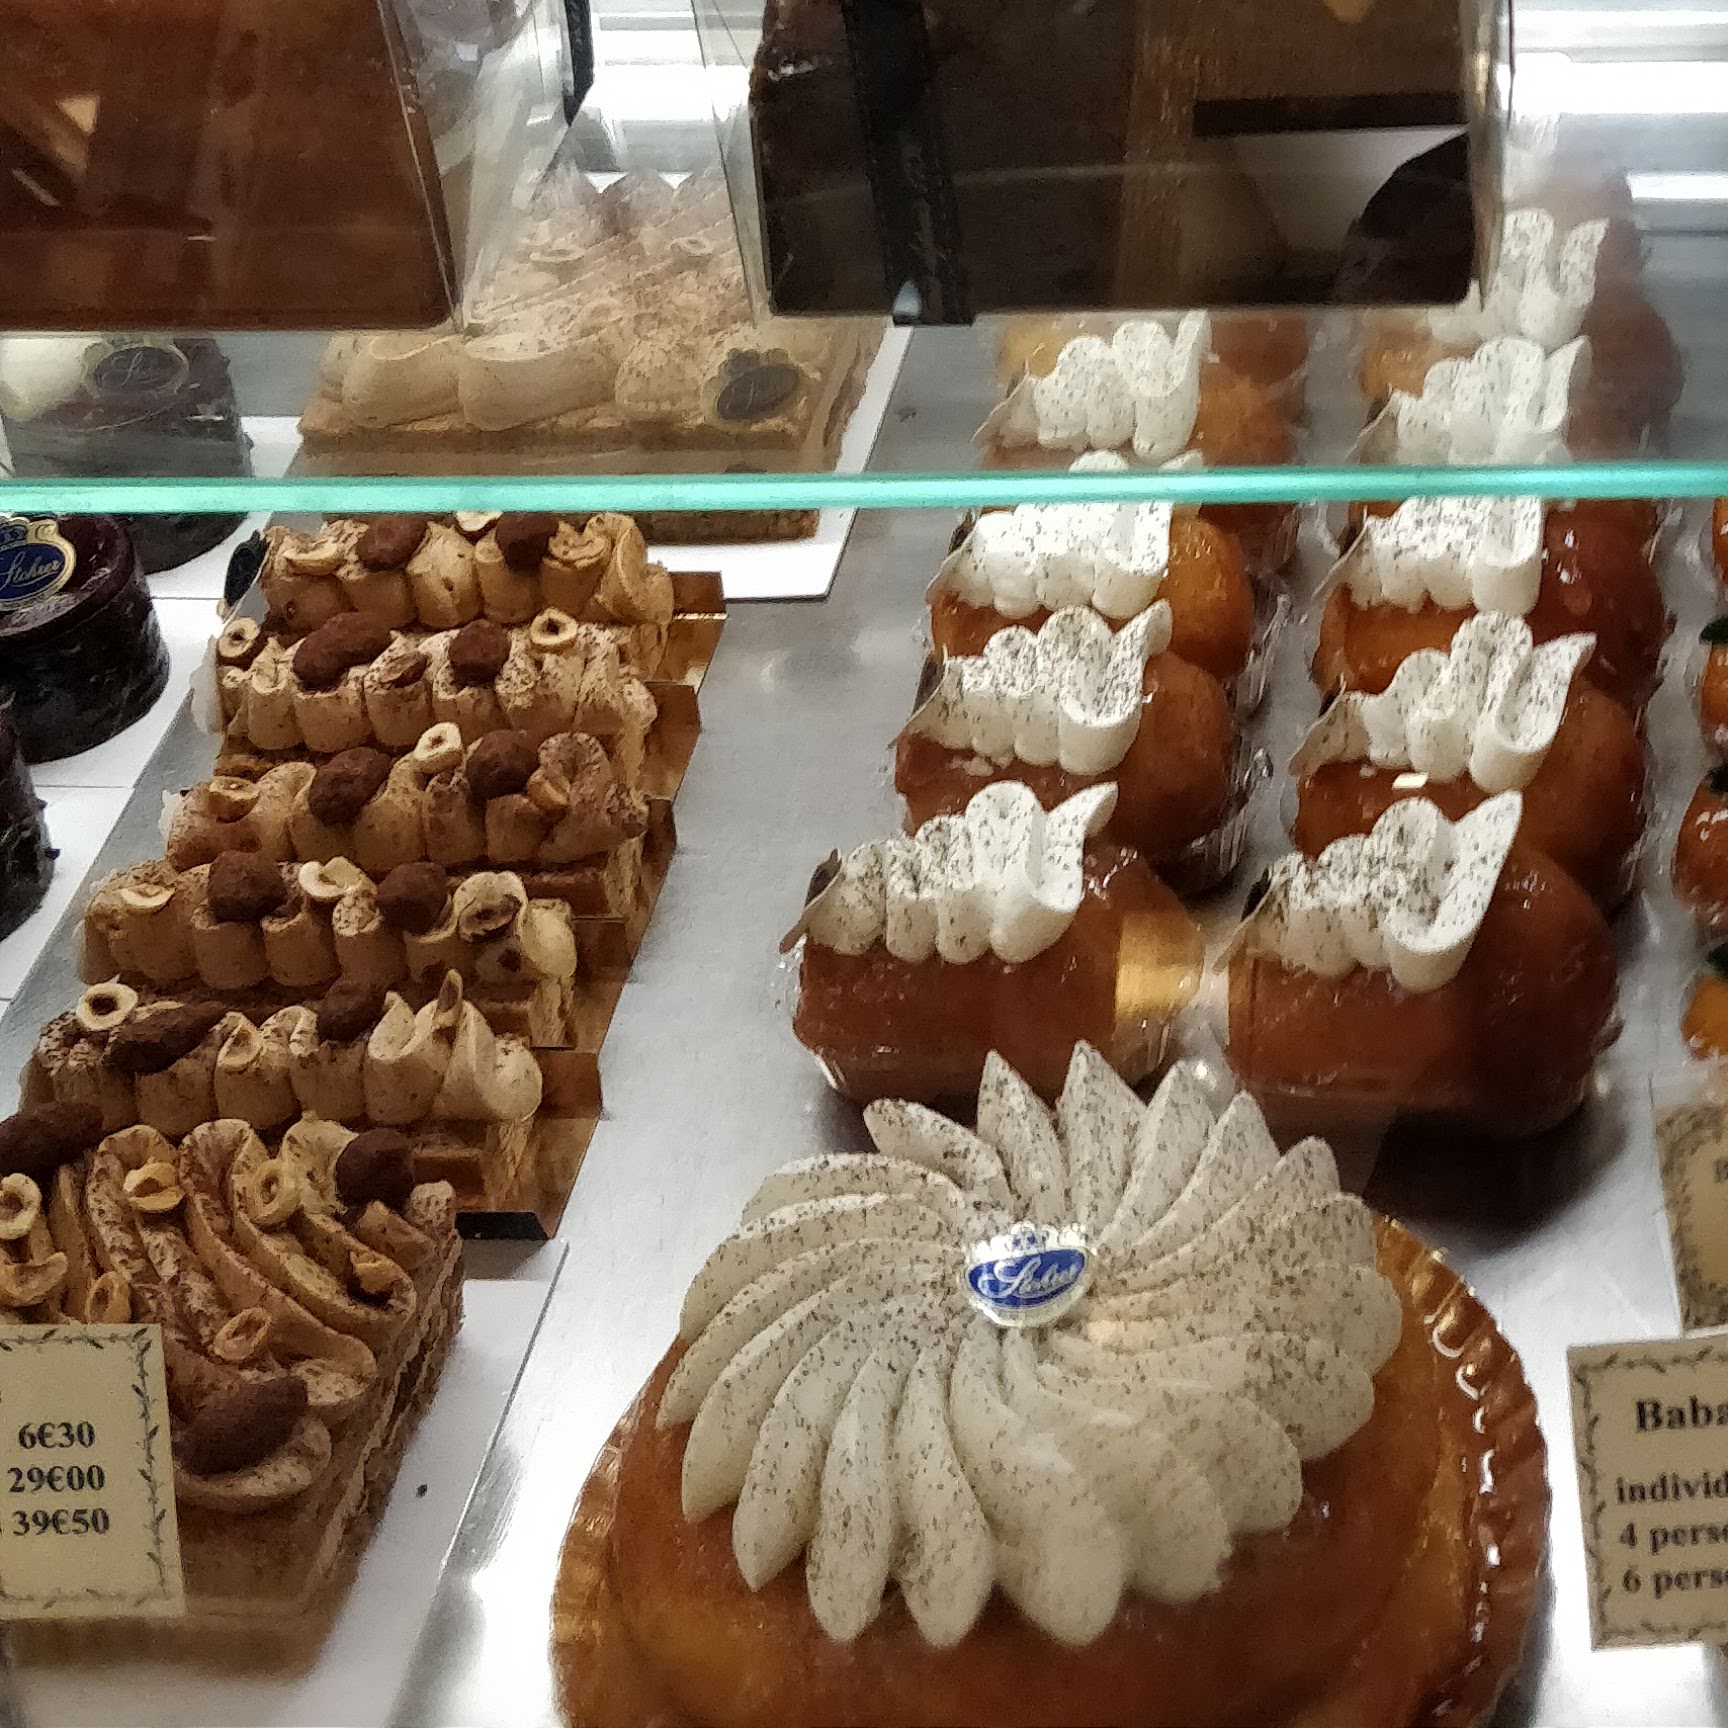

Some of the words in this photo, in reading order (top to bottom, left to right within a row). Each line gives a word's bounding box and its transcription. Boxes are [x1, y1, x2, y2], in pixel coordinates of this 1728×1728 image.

[18, 1421, 95, 1449] 6€30
[8, 1465, 105, 1493] 29€00
[13, 1508, 110, 1536] 39€50
[1619, 1523, 1637, 1548] 4
[1623, 1565, 1642, 1593] 6
